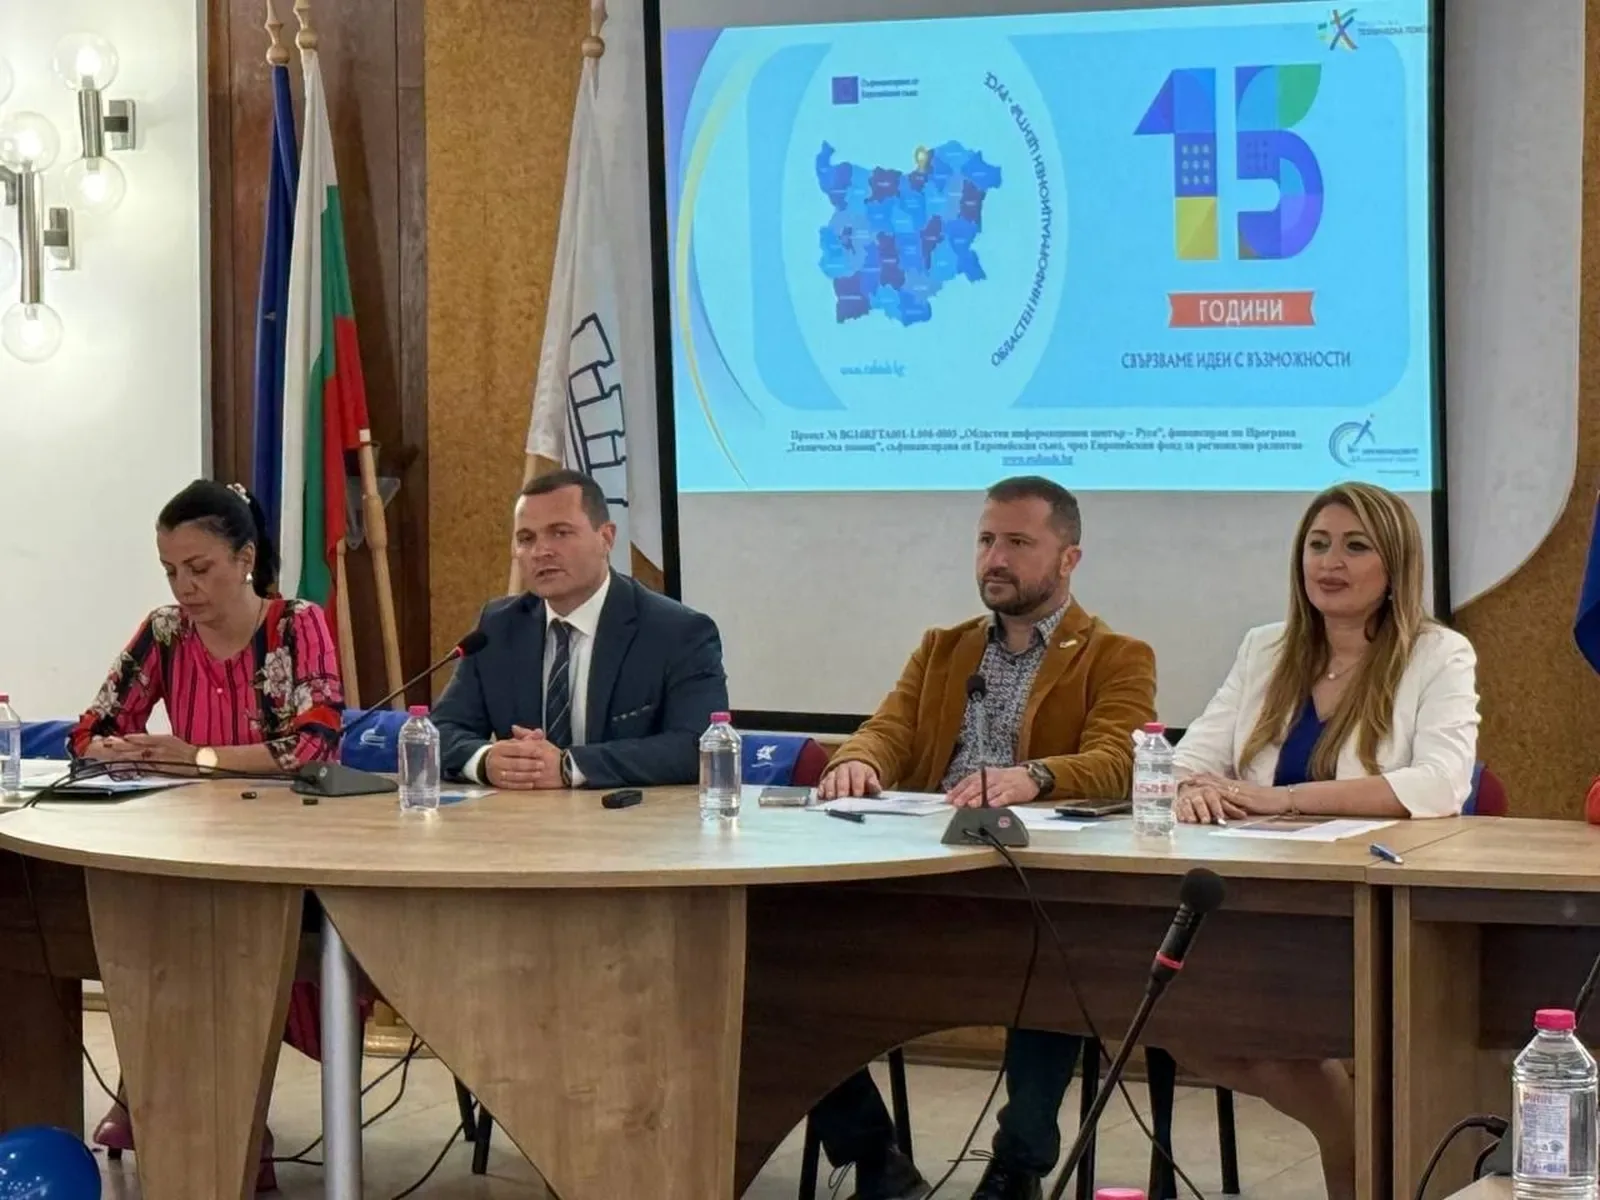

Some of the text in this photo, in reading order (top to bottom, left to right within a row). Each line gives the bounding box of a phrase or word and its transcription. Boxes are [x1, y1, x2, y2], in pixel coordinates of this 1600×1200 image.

[1010, 103, 1041, 156] ЦЕНТЪР
[1133, 64, 1324, 261] 15
[1028, 154, 1054, 306] ИНФОРМАЦИОНЕН
[990, 303, 1035, 368] ОБЛАСТЕН
[1199, 299, 1285, 328] ГОДИНИ
[1121, 350, 1351, 370] СВЪРЗВАМЕ ИДЕИ С ВЪЗМОЖНОСТИ
